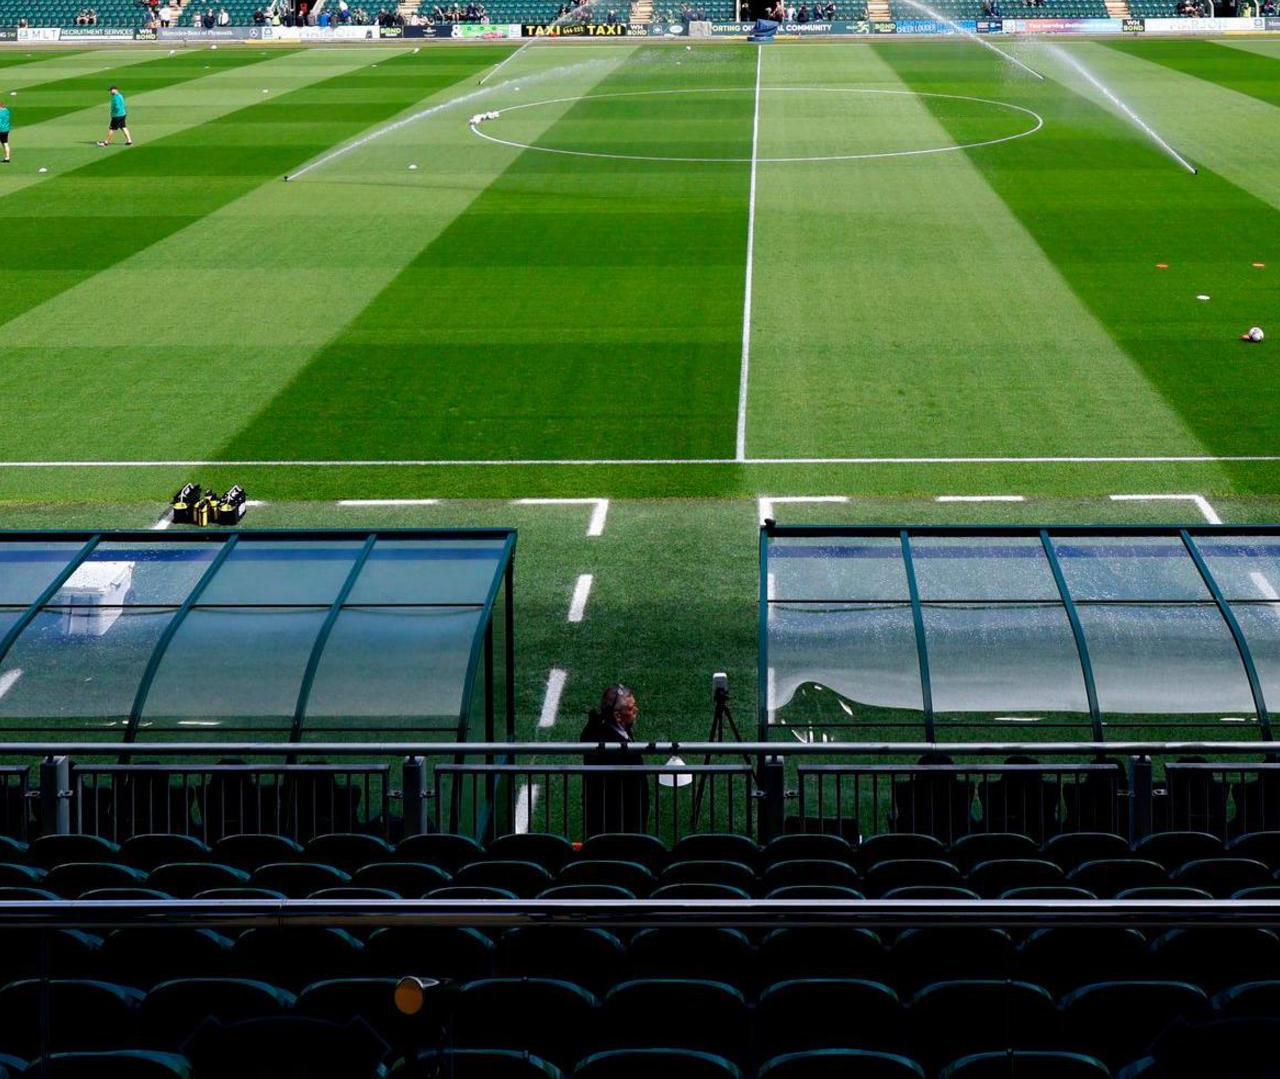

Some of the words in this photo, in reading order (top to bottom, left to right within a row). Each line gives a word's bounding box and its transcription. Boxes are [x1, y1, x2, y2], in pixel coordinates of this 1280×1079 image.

[380, 27, 402, 35] BOND
[526, 25, 561, 36] TAXI
[587, 24, 622, 36] TAXI
[785, 23, 832, 32] COMMUNITY
